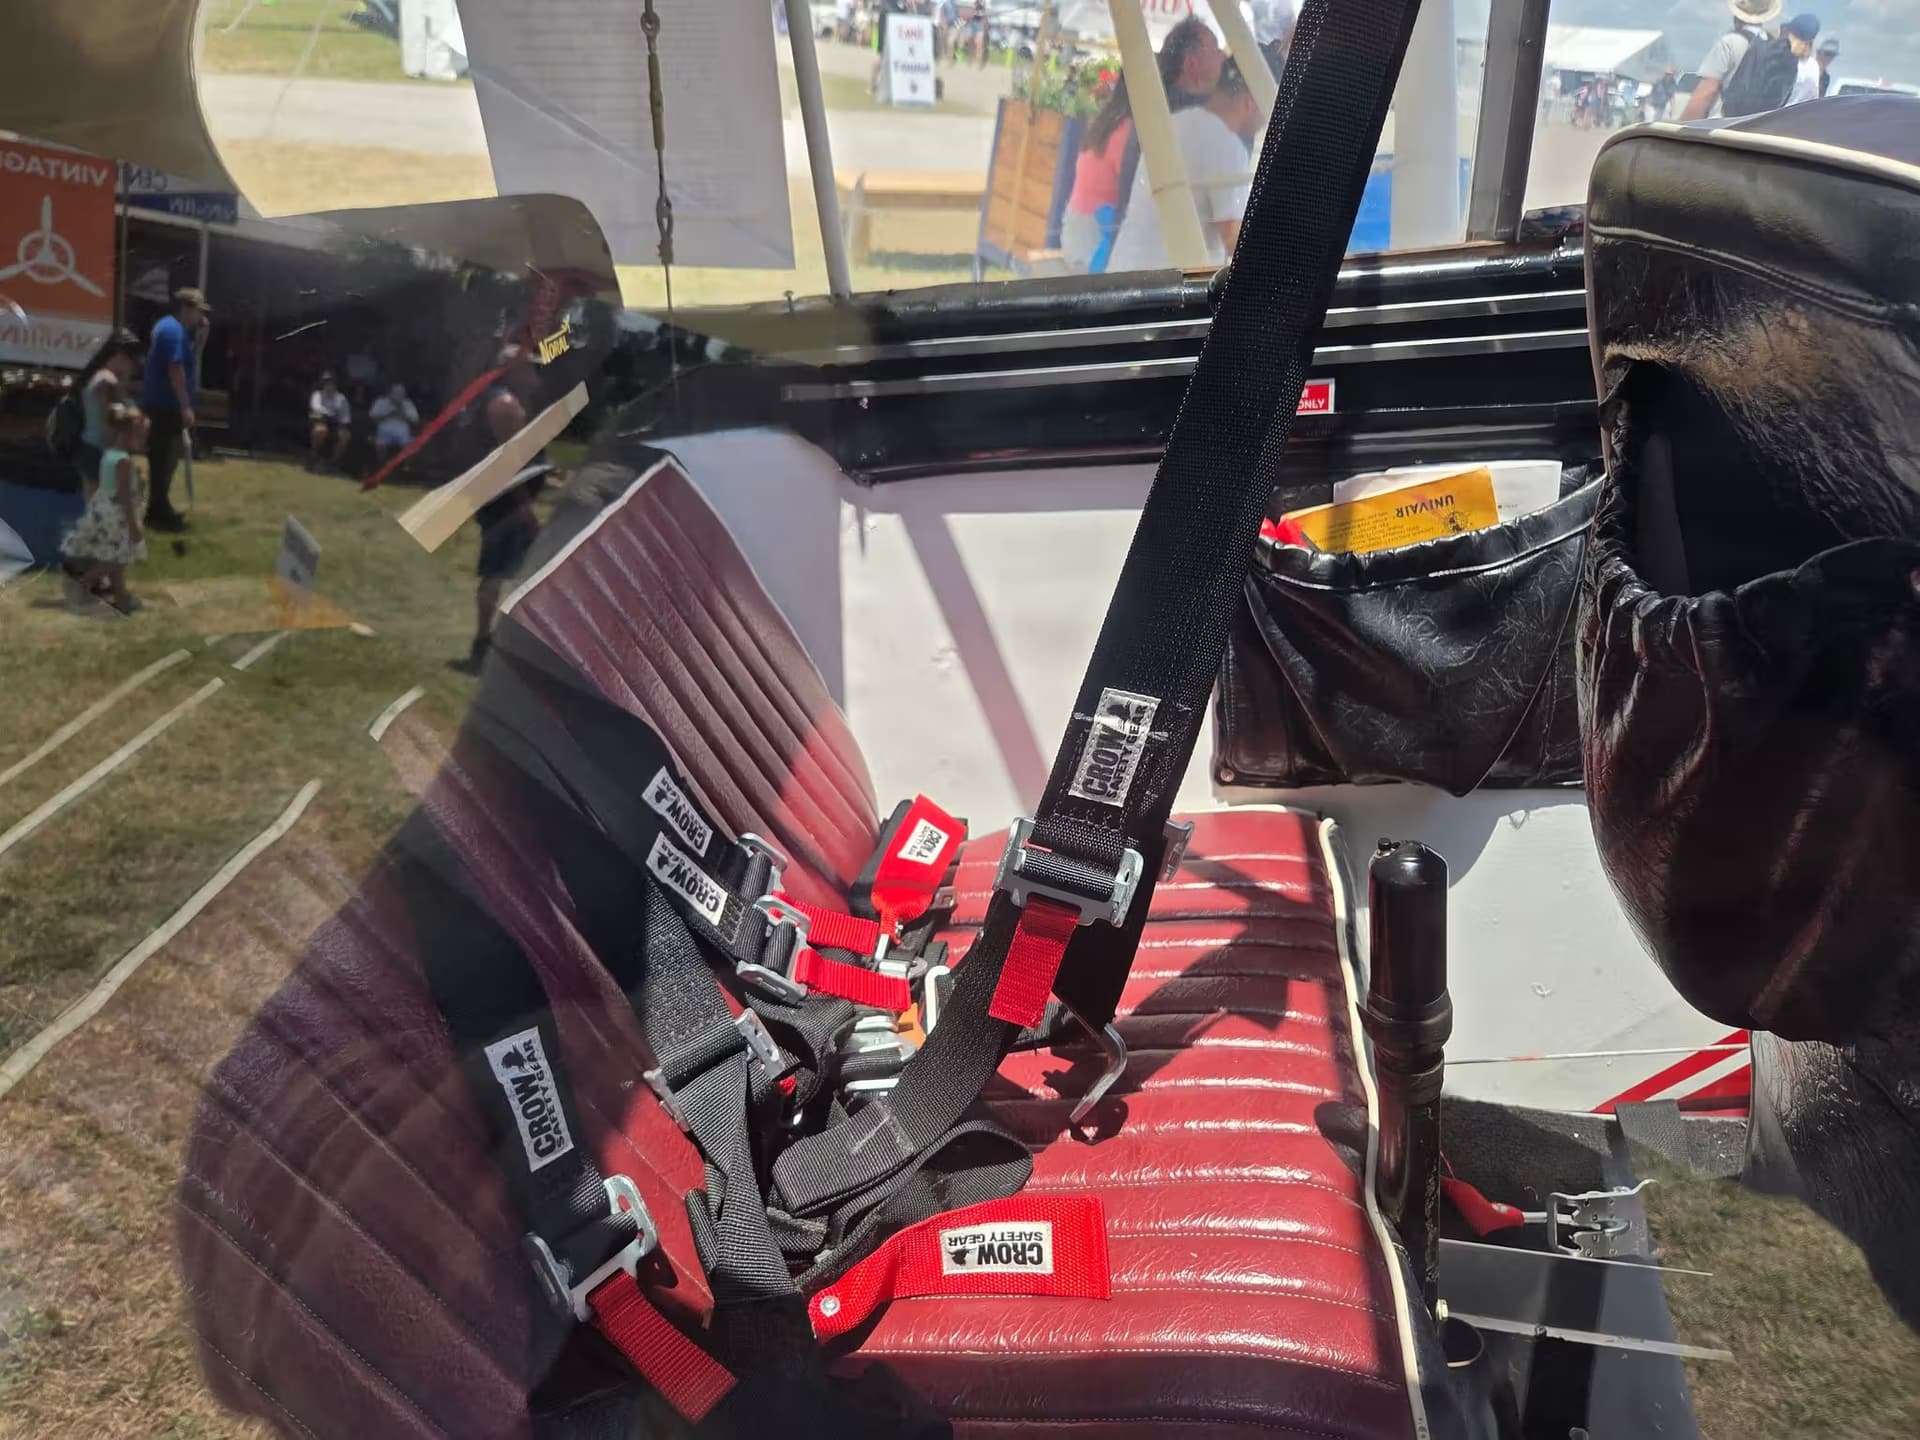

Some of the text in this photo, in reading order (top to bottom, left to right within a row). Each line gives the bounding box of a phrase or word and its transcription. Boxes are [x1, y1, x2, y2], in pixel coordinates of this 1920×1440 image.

[1396, 495, 1454, 518] UNIVAIR
[1081, 723, 1127, 796] CROW
[665, 801, 706, 850] CROW
[667, 864, 721, 912] CROW
[510, 1073, 556, 1158] CROW
[522, 1039, 565, 1148] SAFETY GEAR
[948, 1231, 1043, 1247] SAFETY GEAR
[977, 1243, 1043, 1265] CROW
